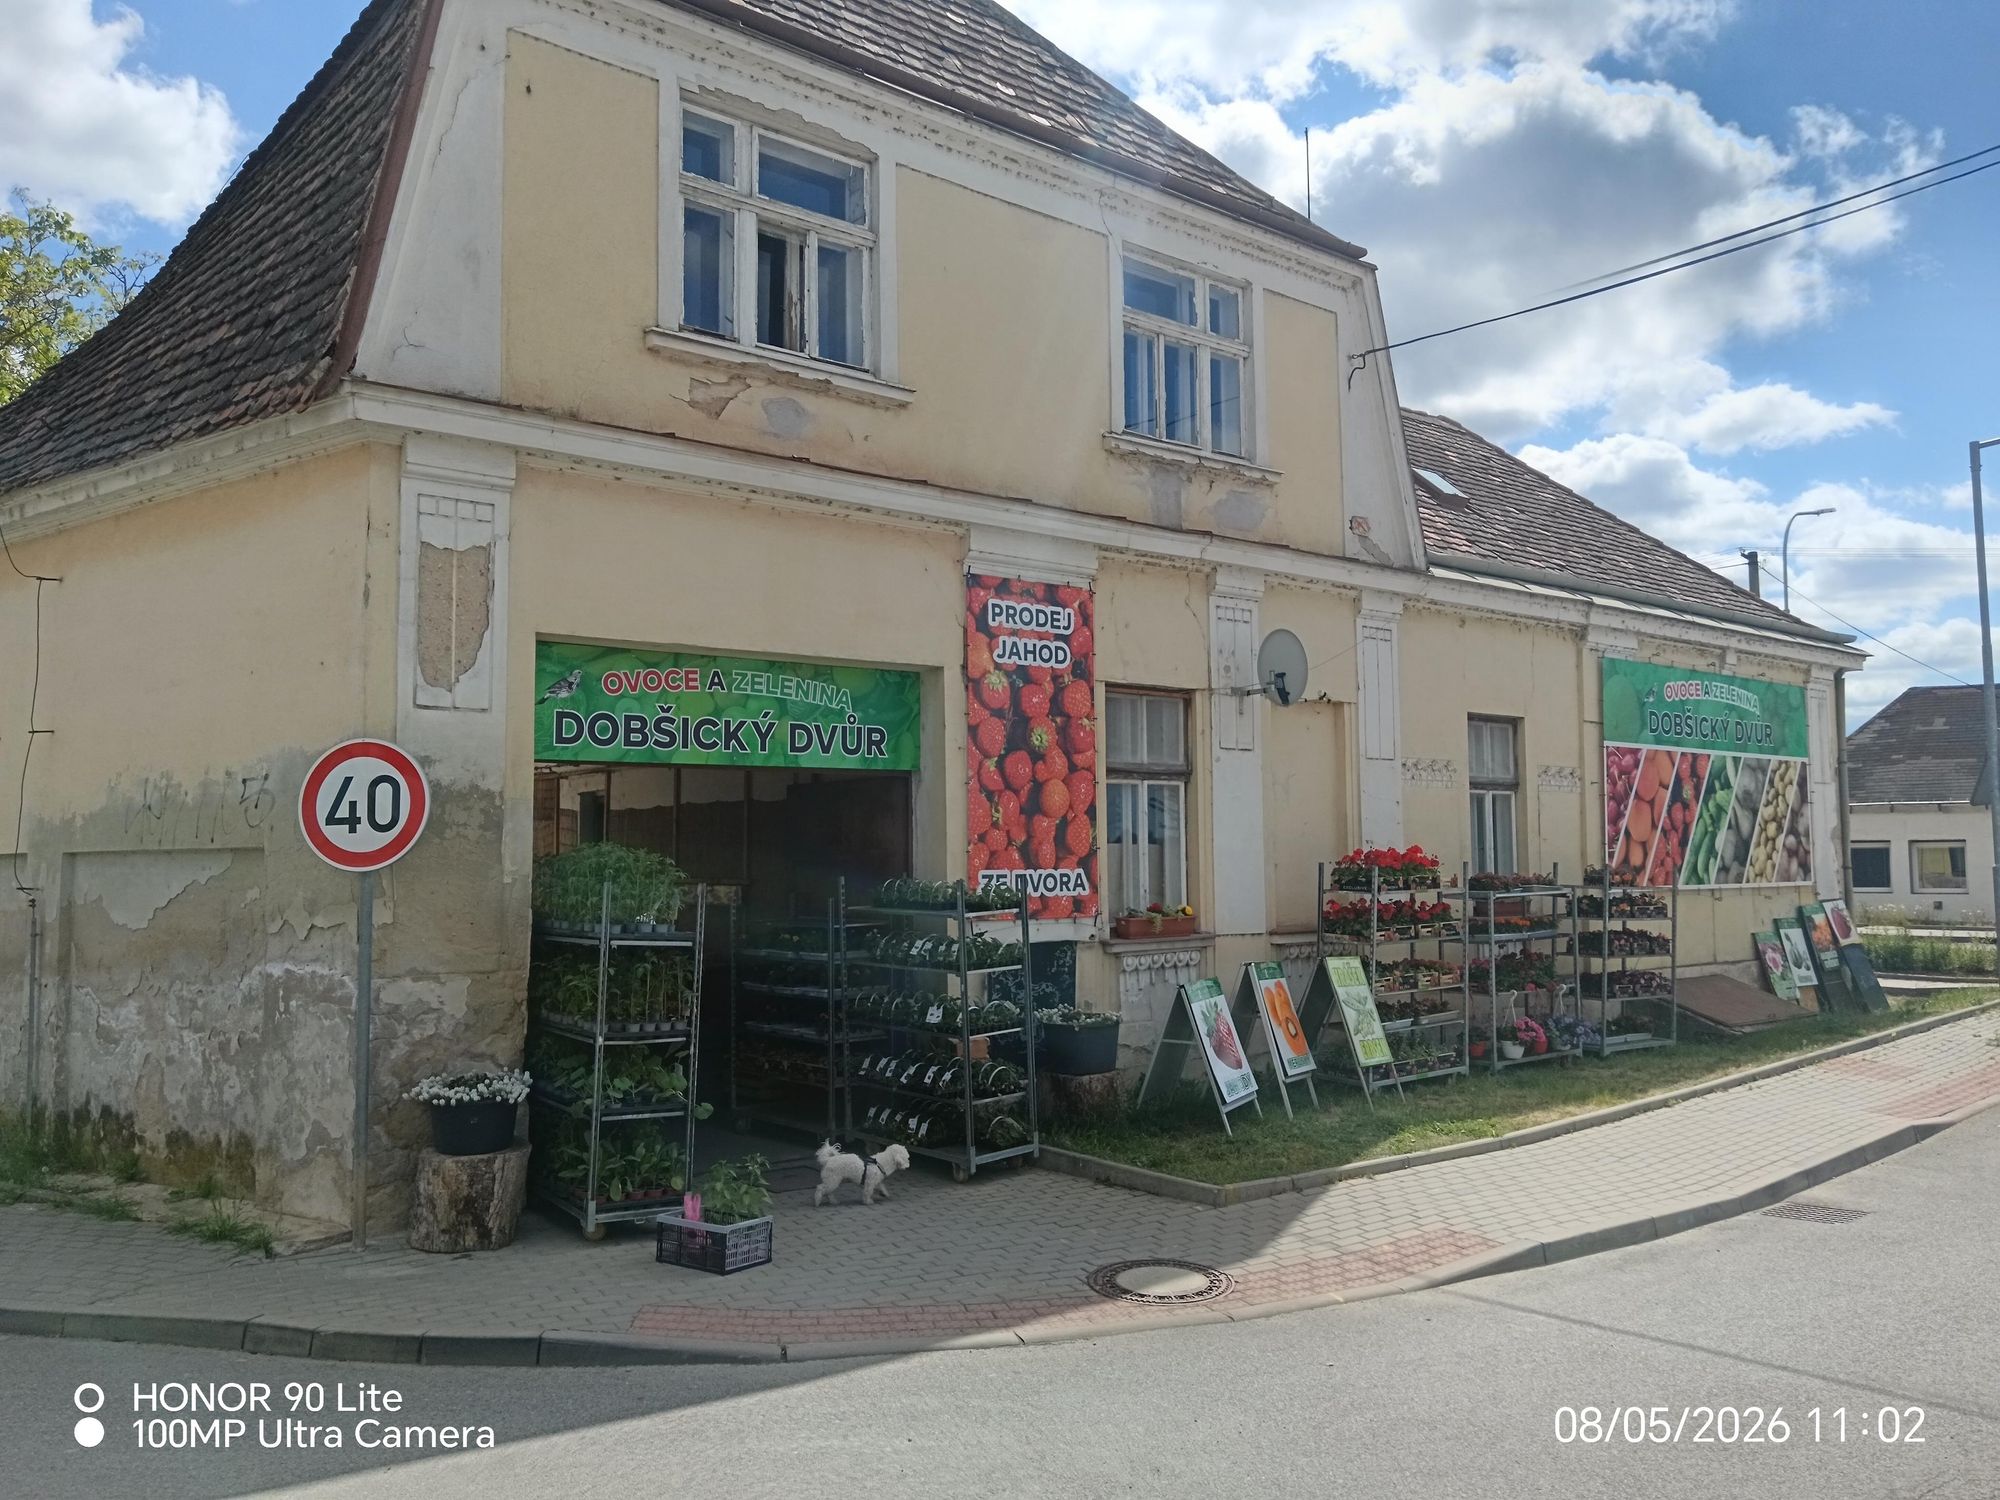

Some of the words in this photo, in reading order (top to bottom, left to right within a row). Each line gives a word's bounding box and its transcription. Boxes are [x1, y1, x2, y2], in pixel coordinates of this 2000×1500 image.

[990, 601, 1073, 632] PRODEJ
[996, 638, 1069, 666] JAHOD
[602, 668, 700, 696] OVOCE
[706, 669, 727, 692] A
[732, 670, 852, 712] ZELENINA
[1664, 681, 1701, 701] OVOCE
[1703, 681, 1711, 698] A
[1711, 682, 1760, 715] ZELENINA
[553, 704, 777, 753] DOBŠICKÝ
[788, 712, 888, 758] DVŮR
[1648, 706, 1730, 742] DOBŠICKÝ
[1735, 714, 1774, 746] DVŮR
[325, 775, 401, 833] 40
